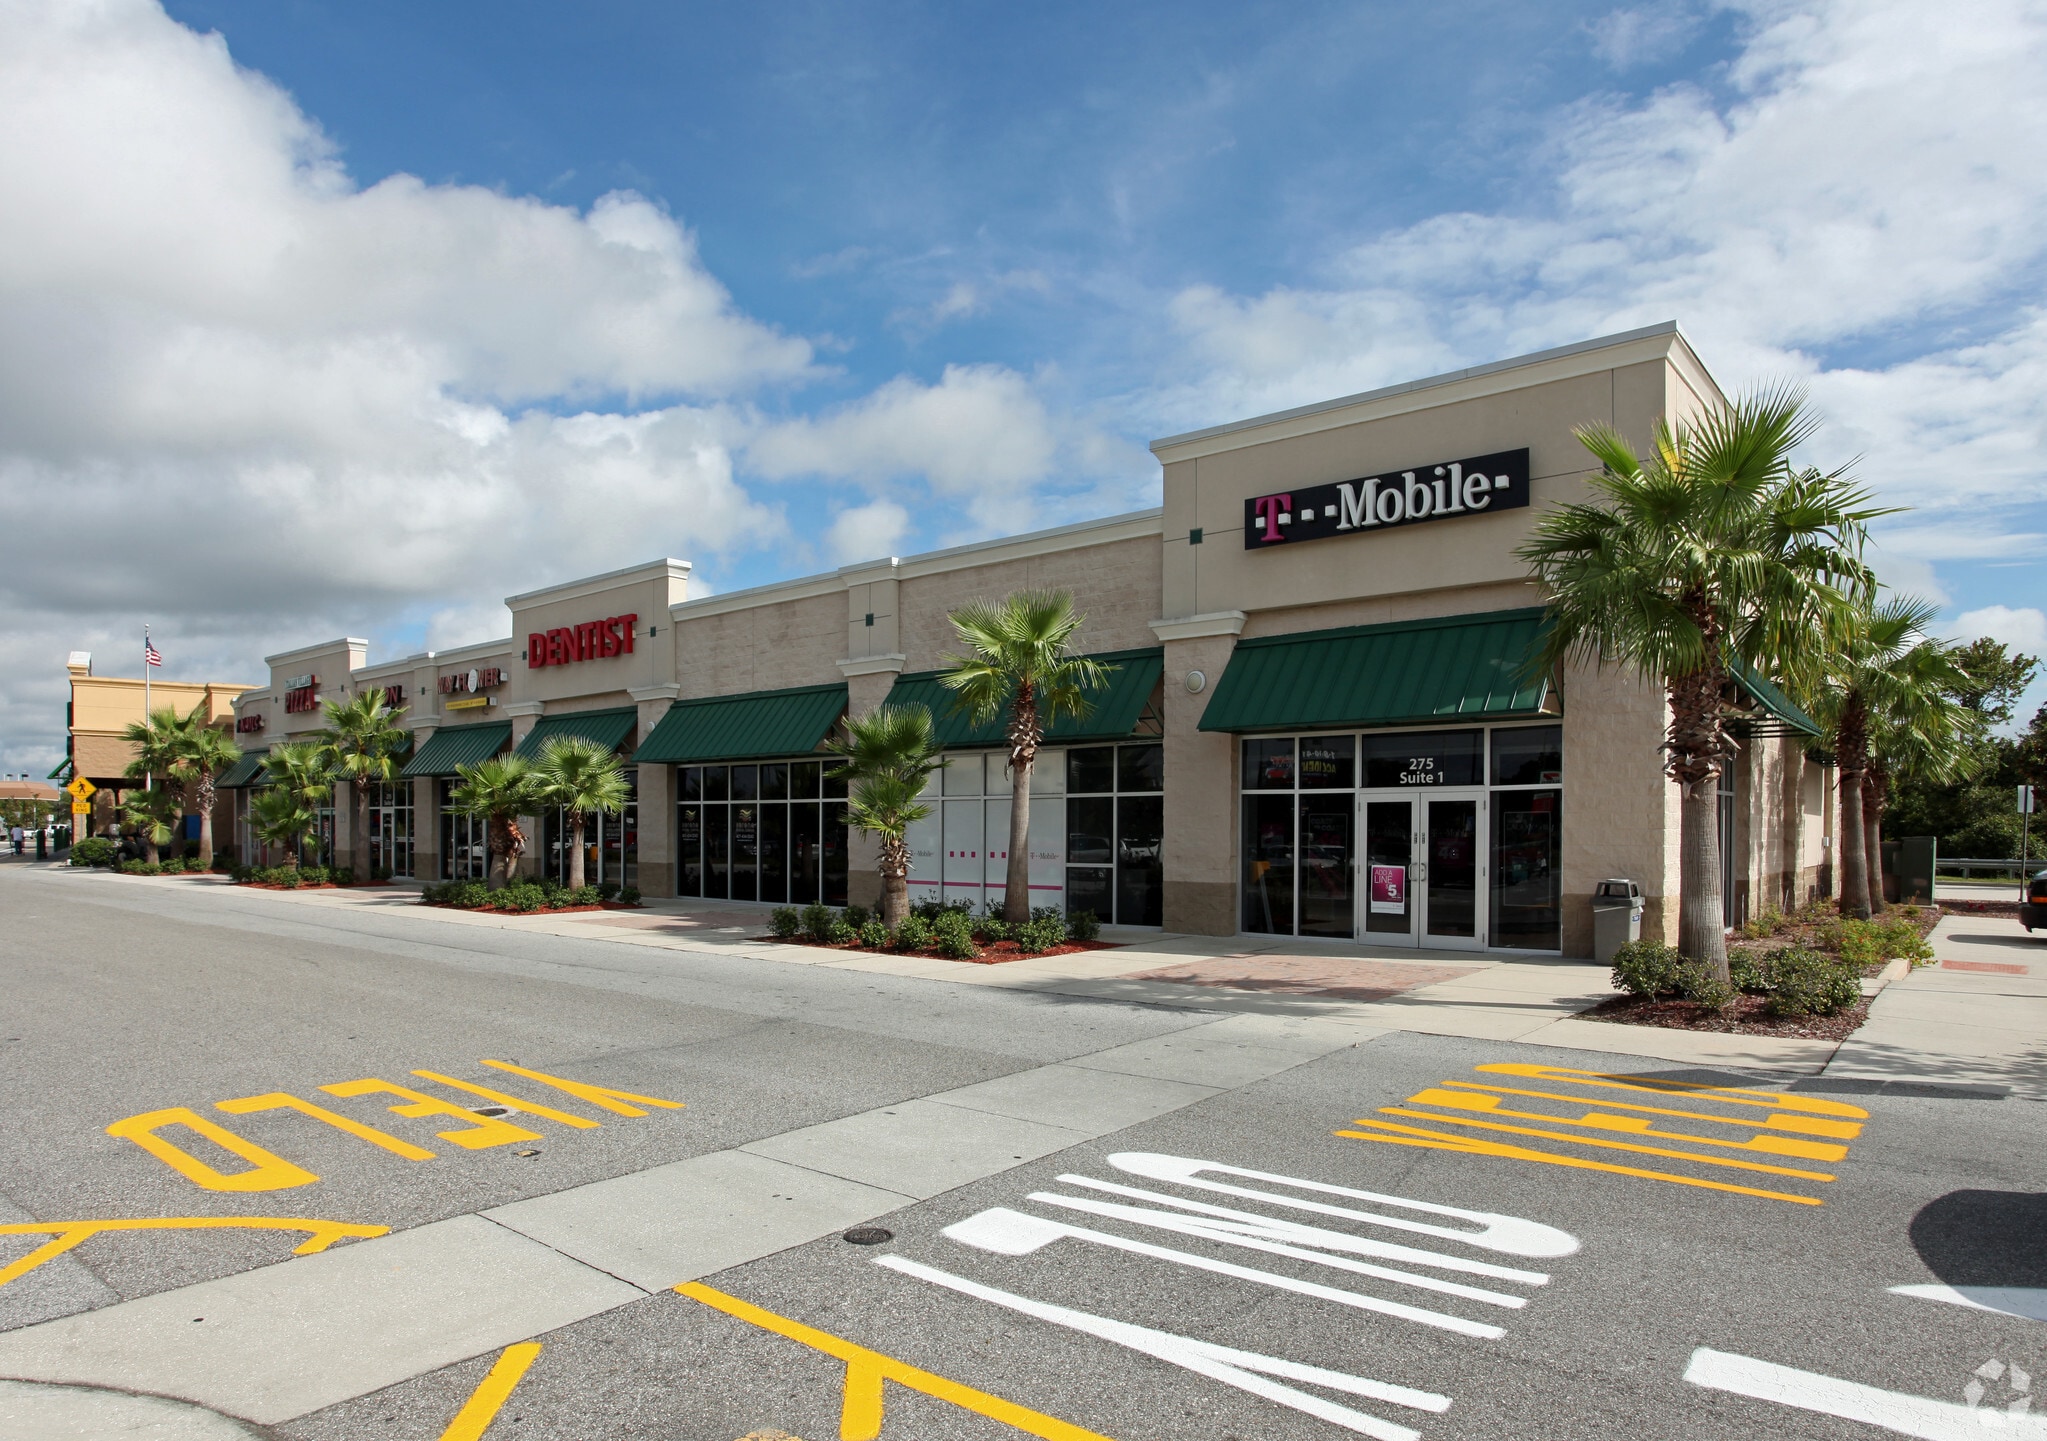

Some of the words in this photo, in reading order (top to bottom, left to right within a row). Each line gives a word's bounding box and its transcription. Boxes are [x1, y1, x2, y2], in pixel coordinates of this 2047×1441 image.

[528, 613, 638, 669] DENTIST
[285, 687, 316, 714] PIZZA
[1409, 757, 1434, 770] 275
[1399, 771, 1434, 784] Suite
[1437, 771, 1444, 783] 1
[1374, 875, 1393, 884] LINE
